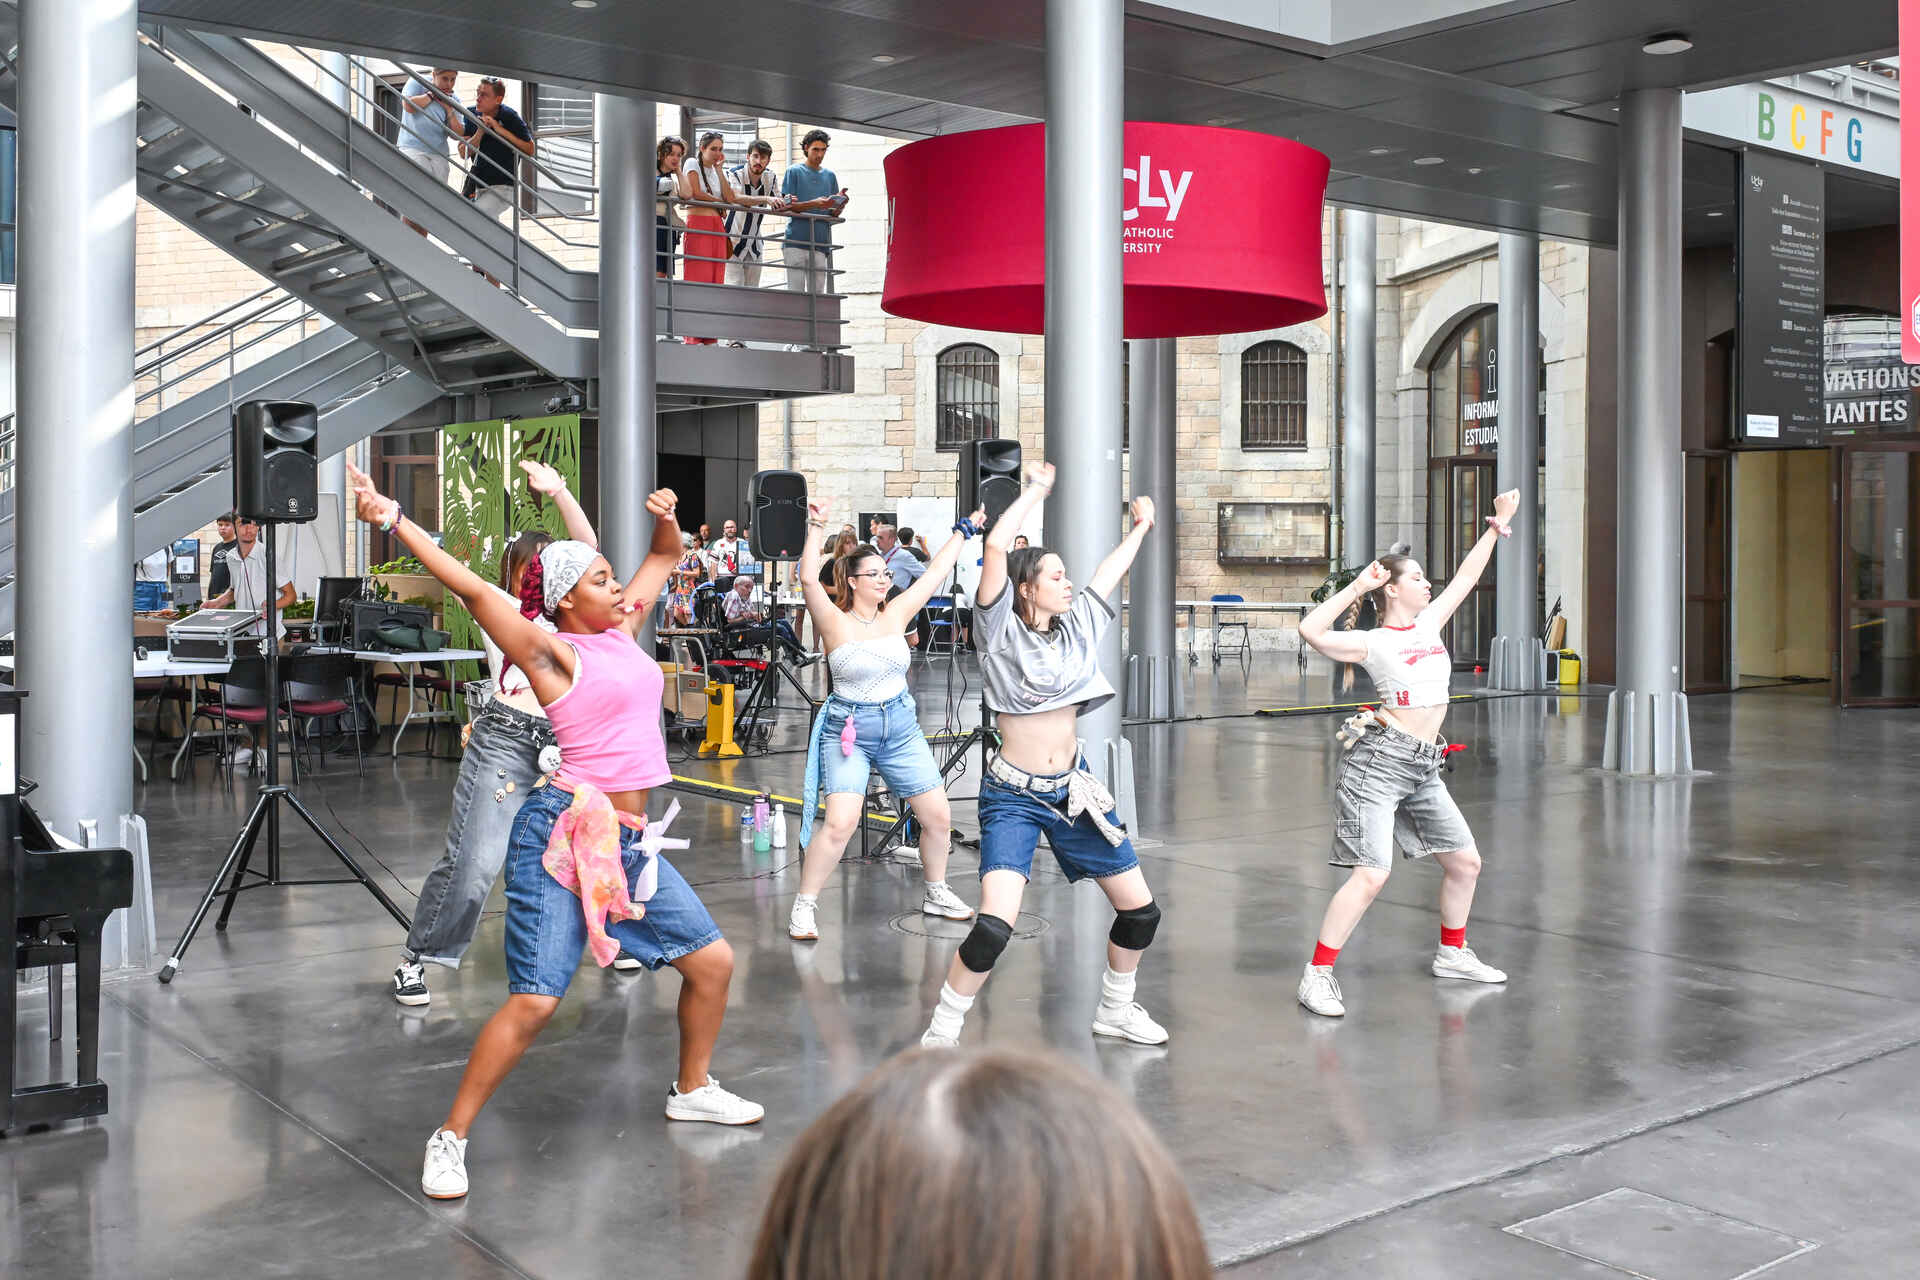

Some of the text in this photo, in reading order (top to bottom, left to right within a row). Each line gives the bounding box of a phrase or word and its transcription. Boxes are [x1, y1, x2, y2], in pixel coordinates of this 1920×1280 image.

[1758, 93, 1862, 162] B C F G
[1123, 227, 1174, 238] ATHOLIC
[1123, 242, 1162, 253] ERSITY
[1825, 399, 1908, 424] IANTES
[1465, 427, 1499, 446] ESTUDIA
